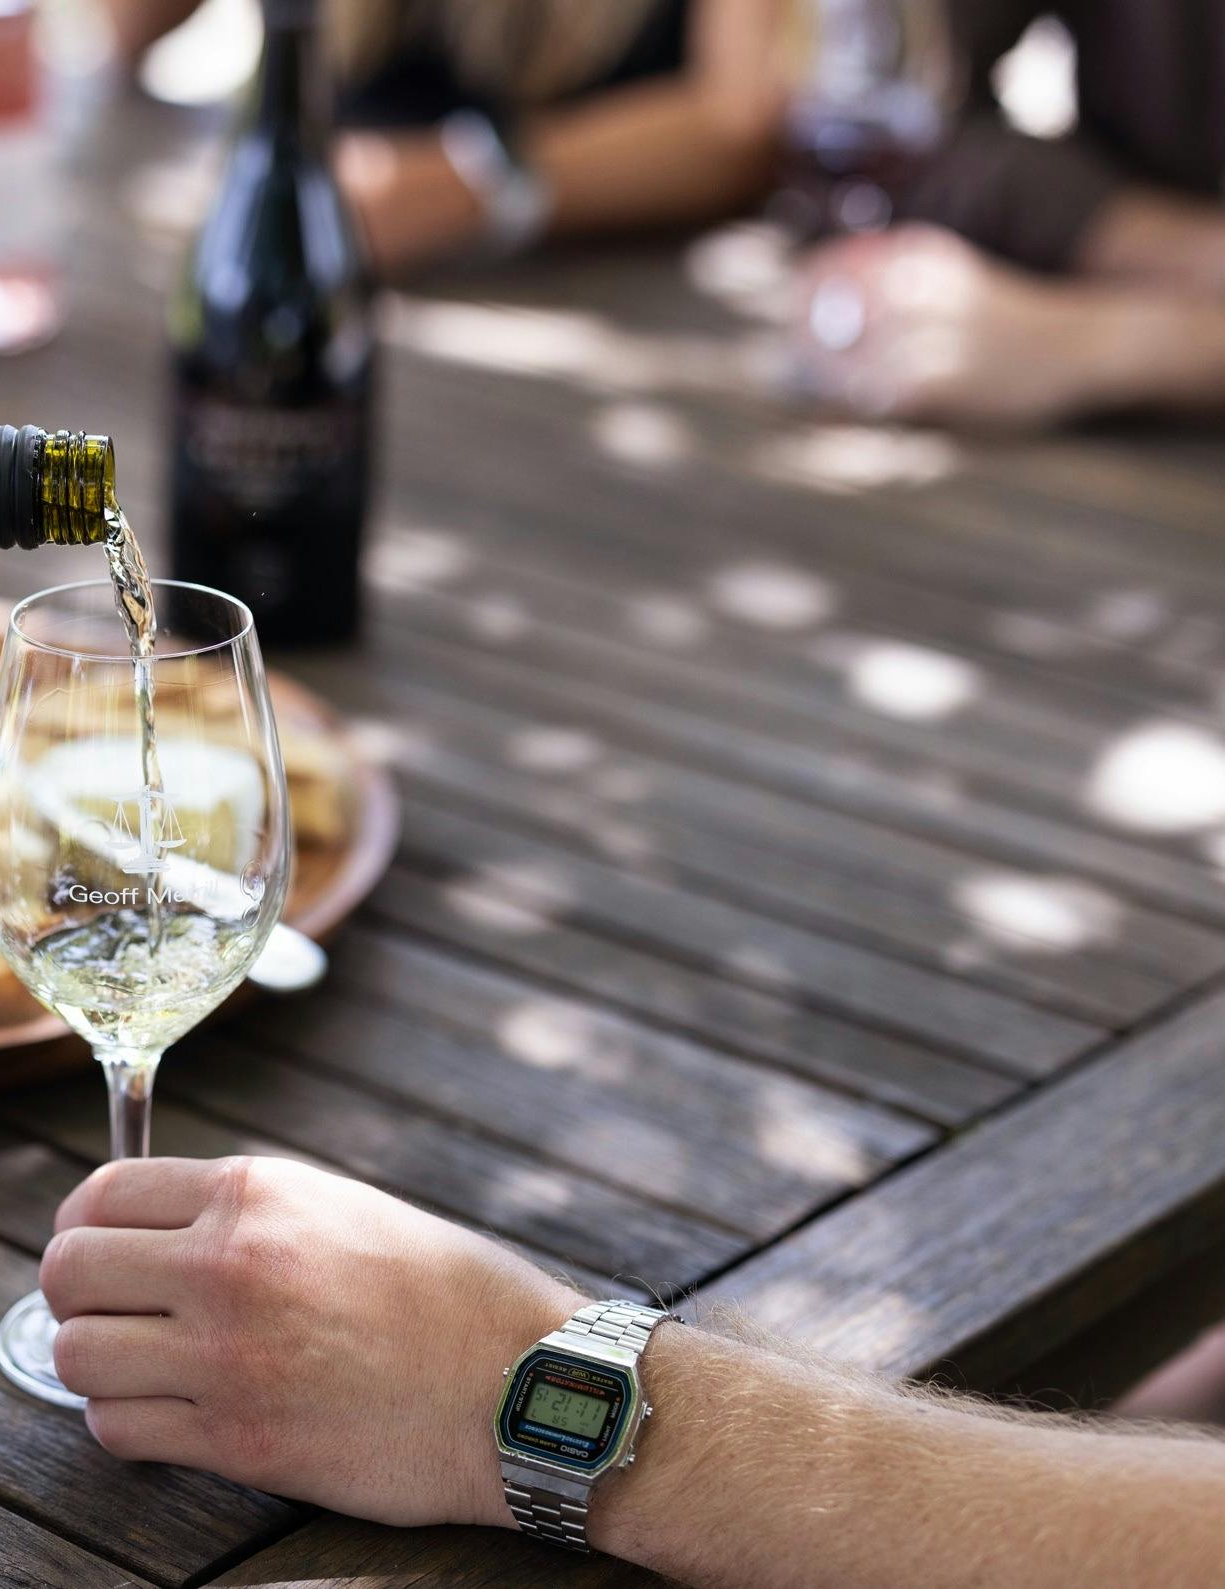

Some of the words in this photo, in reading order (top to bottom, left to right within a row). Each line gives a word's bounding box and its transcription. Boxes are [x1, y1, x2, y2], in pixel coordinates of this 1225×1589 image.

[68, 883, 139, 905] Geoff
[147, 878, 222, 905] Meill
[515, 1376, 532, 1412] START/STOP
[560, 1444, 589, 1458] CASIO
